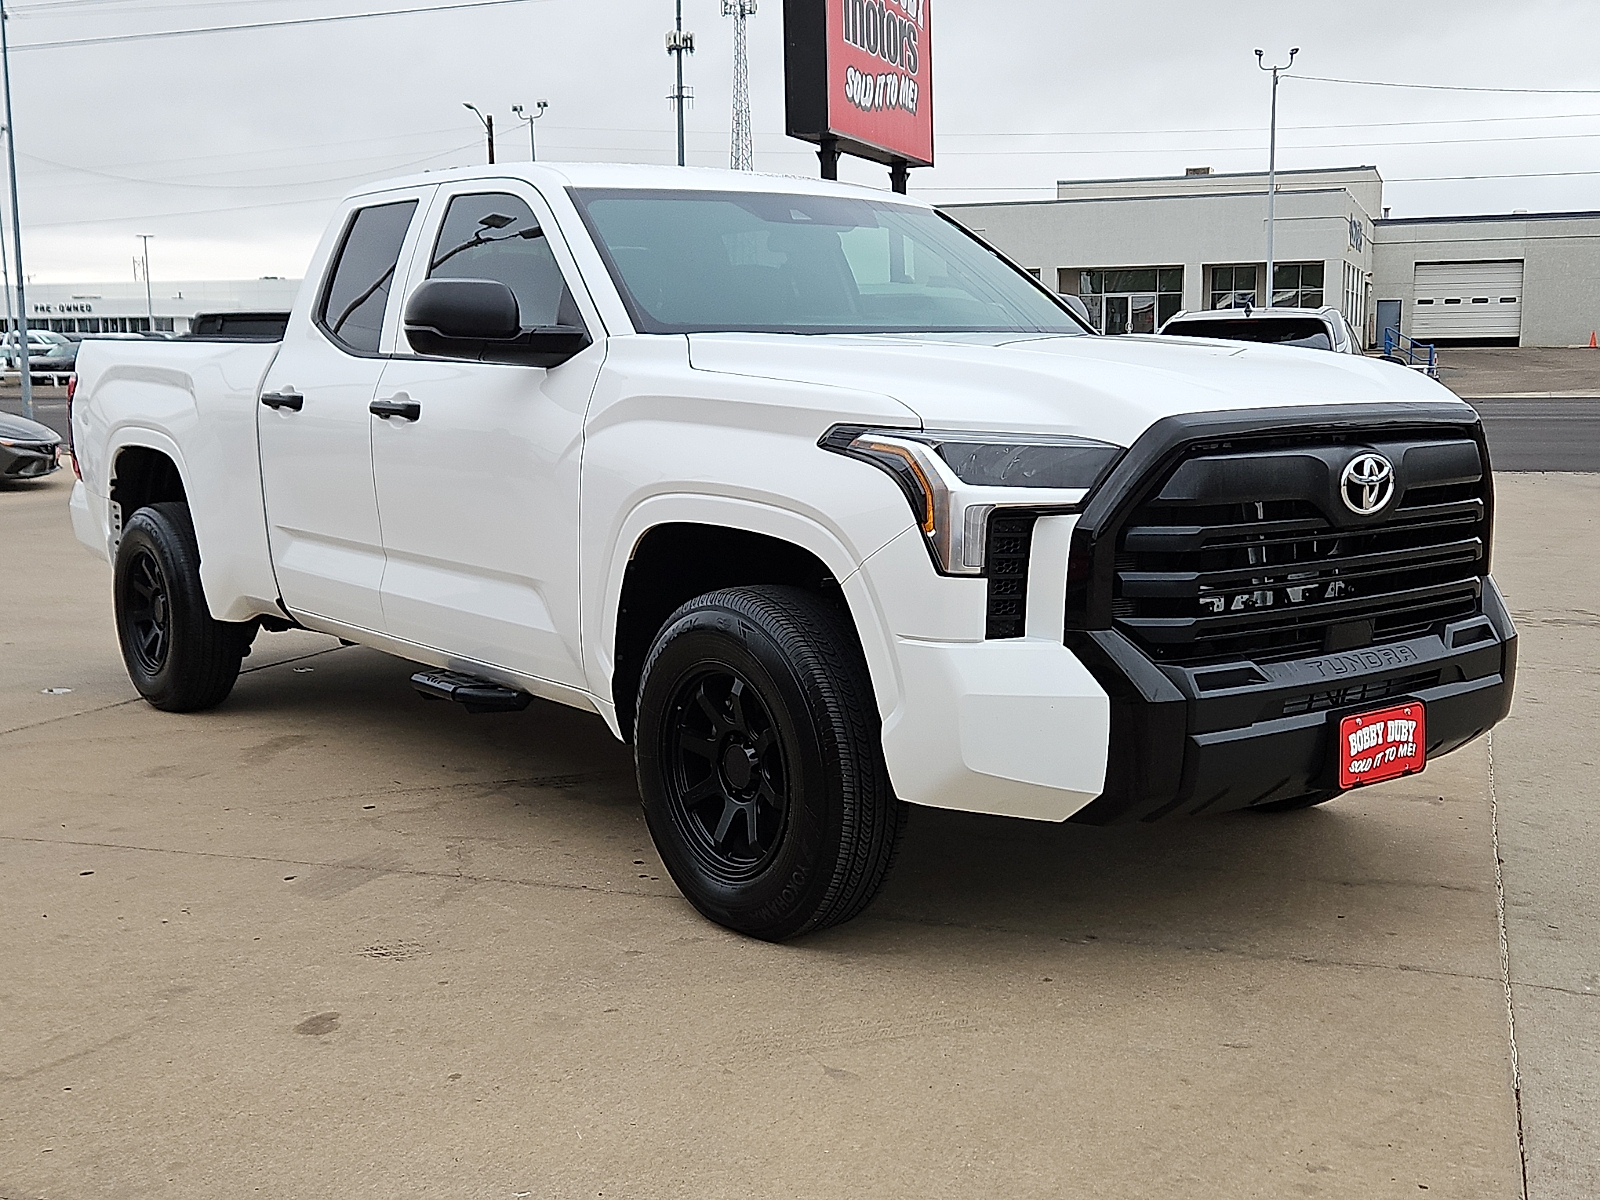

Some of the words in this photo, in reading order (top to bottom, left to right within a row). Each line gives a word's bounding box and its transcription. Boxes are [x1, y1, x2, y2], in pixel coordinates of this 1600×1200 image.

[842, 0, 918, 76] motors
[845, 66, 874, 112] SOLD
[874, 73, 886, 112] IT
[885, 72, 899, 110] TO
[899, 73, 918, 116] ME!
[1304, 645, 1418, 677] TUNDRA
[1348, 721, 1385, 757] BOBBY
[1386, 719, 1417, 743] DUBY
[1348, 757, 1373, 773] SOLD
[1373, 751, 1385, 769] IT
[1384, 746, 1397, 764] TO
[1397, 743, 1417, 758] ME!
